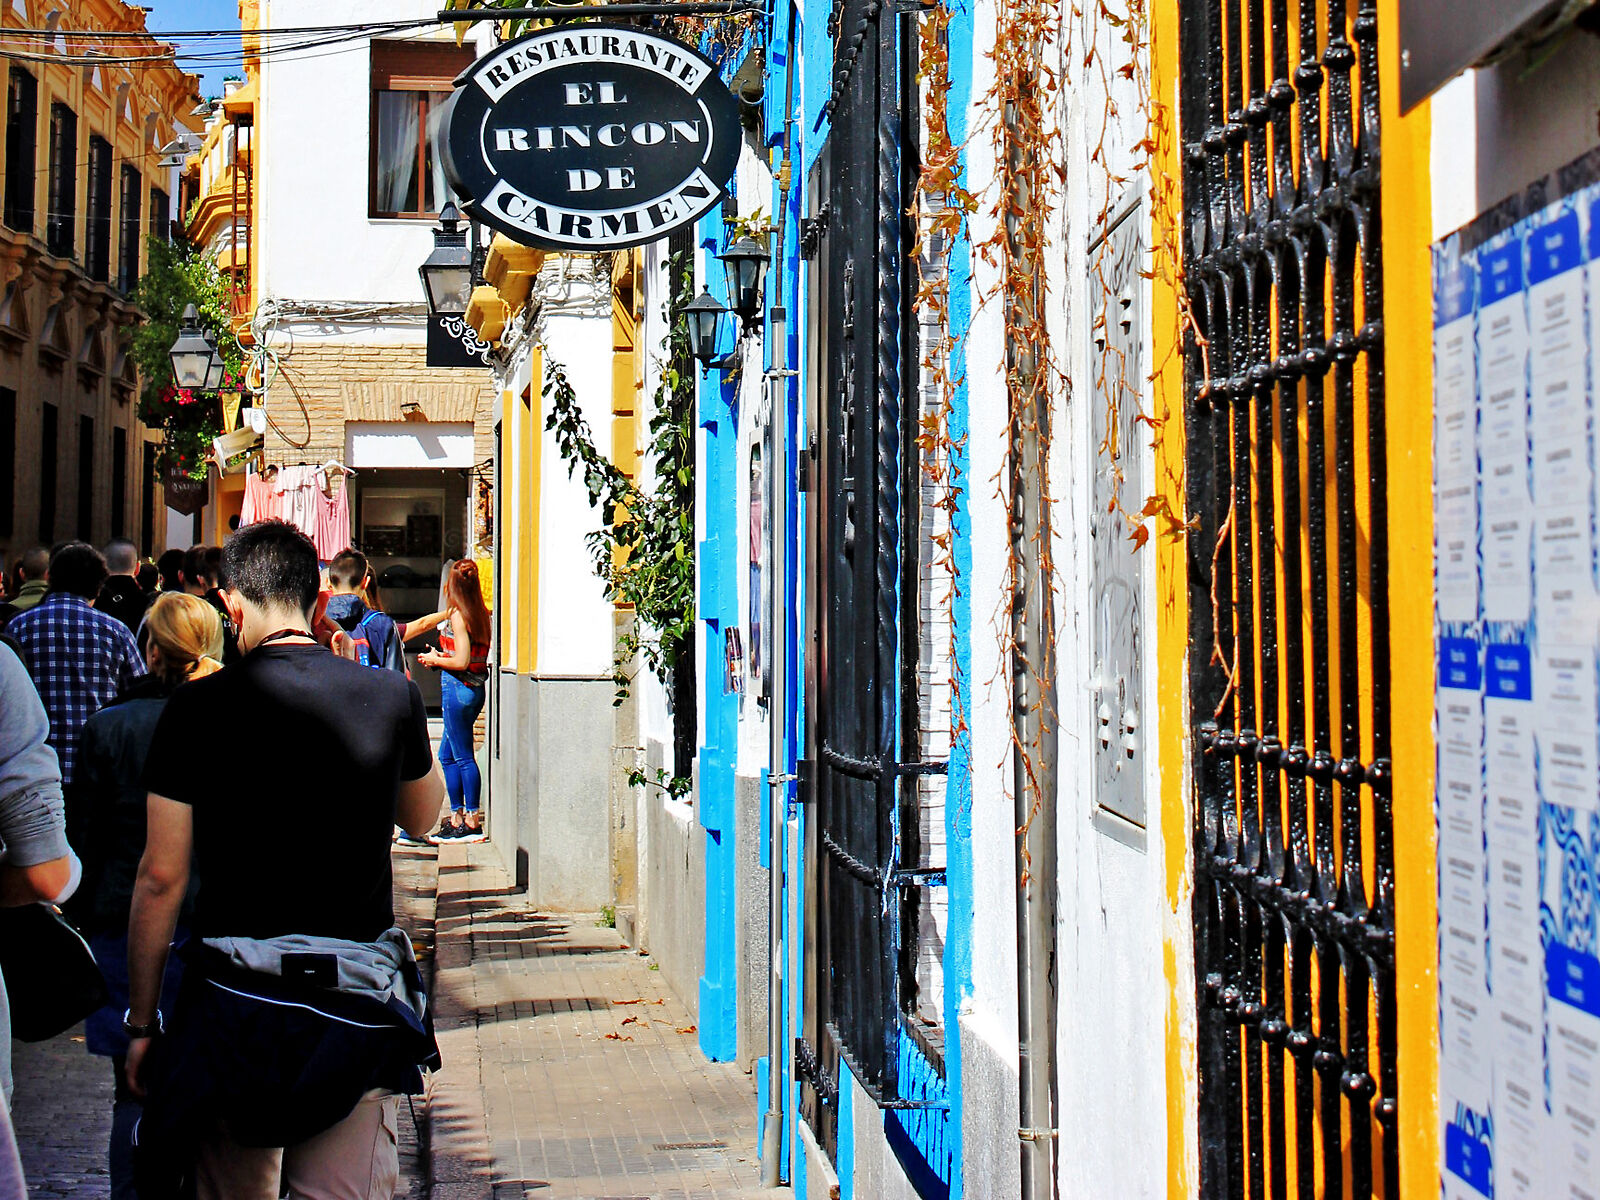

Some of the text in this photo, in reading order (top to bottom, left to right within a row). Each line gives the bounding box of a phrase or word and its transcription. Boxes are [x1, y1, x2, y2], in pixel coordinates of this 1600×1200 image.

[485, 35, 699, 92] RESTAURANTE
[562, 81, 628, 106] EL
[493, 119, 701, 152] RINCON
[566, 166, 637, 193] DE
[497, 173, 711, 240] CARMEN
